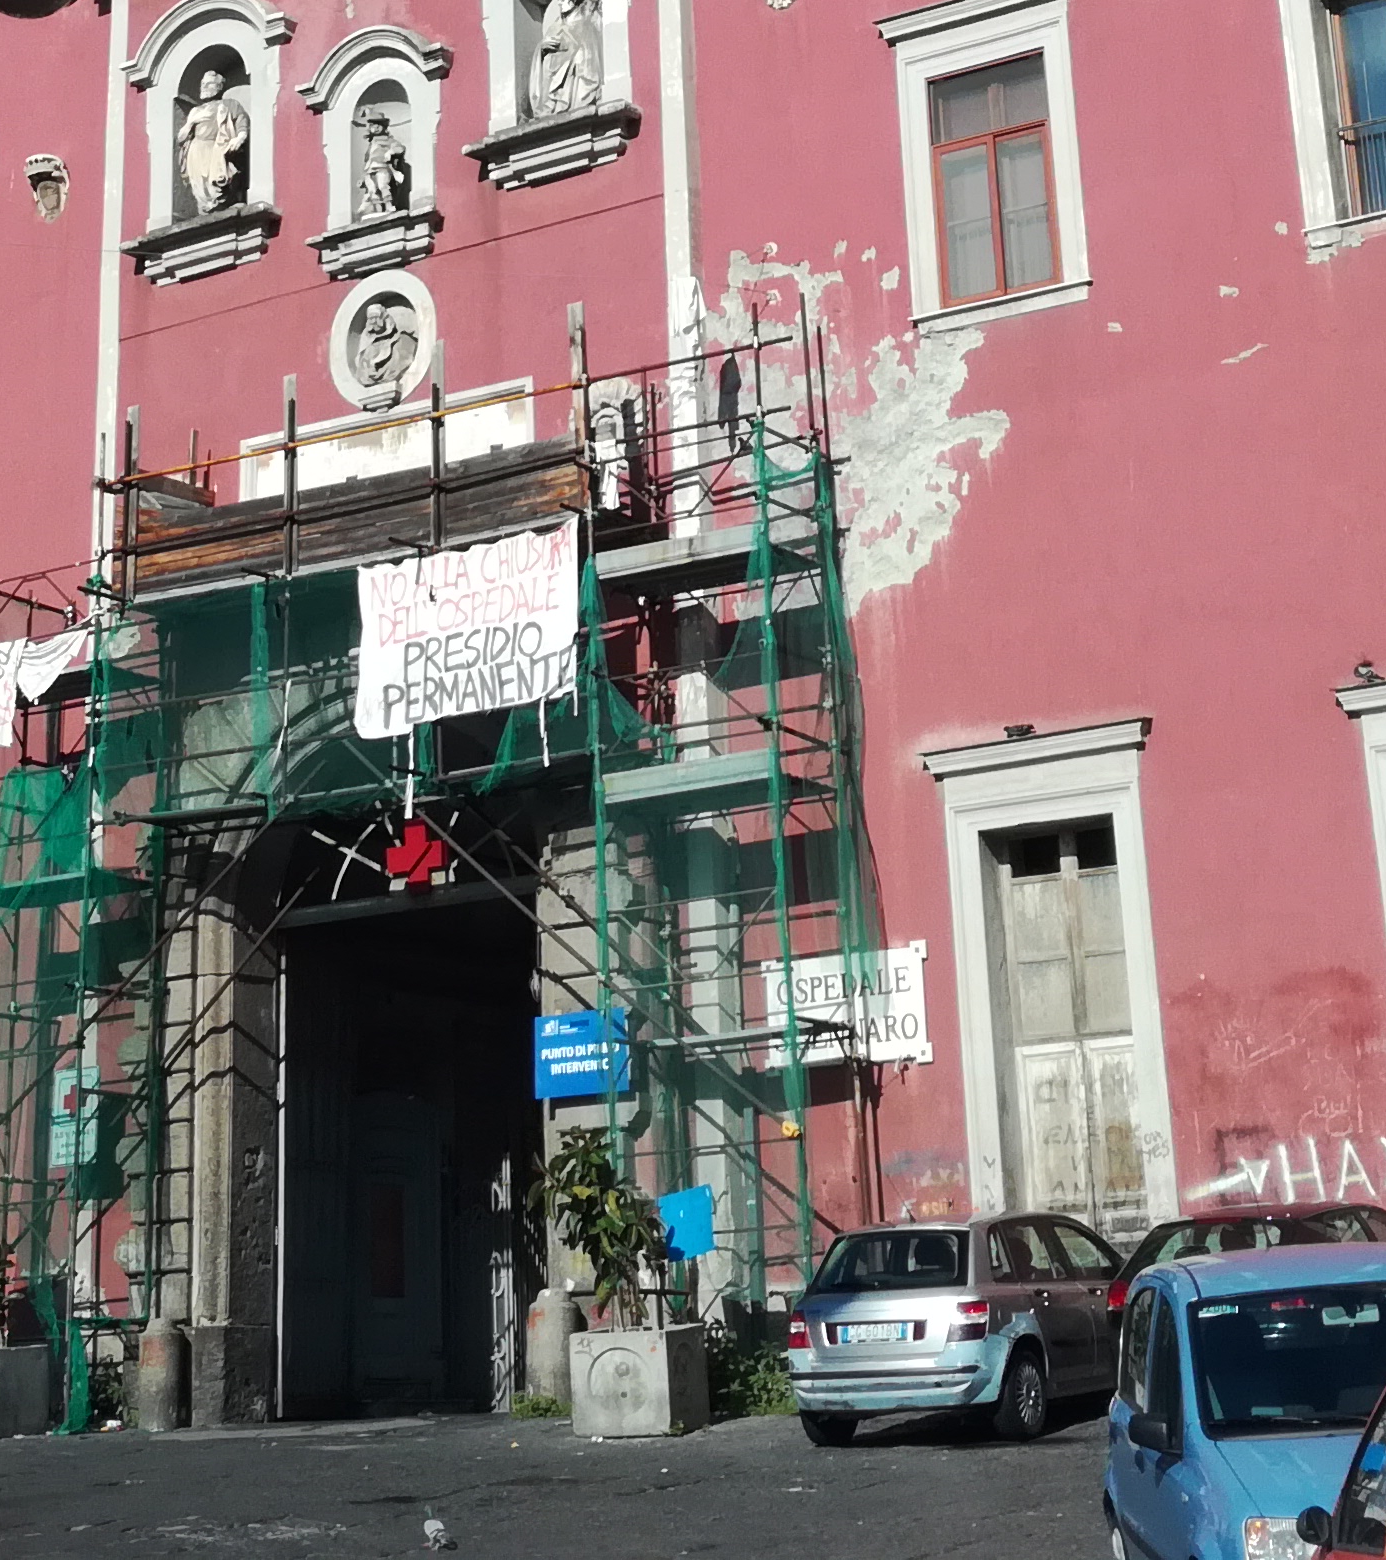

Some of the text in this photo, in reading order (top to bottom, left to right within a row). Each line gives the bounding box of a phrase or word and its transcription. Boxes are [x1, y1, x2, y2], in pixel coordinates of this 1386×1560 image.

[370, 522, 573, 612] NO ALLA CHIUSURA
[404, 621, 543, 684] PRESIDIO
[776, 965, 912, 1006] OSPEDALE
[541, 1045, 574, 1060] PUNTO
[575, 1044, 586, 1056] DI
